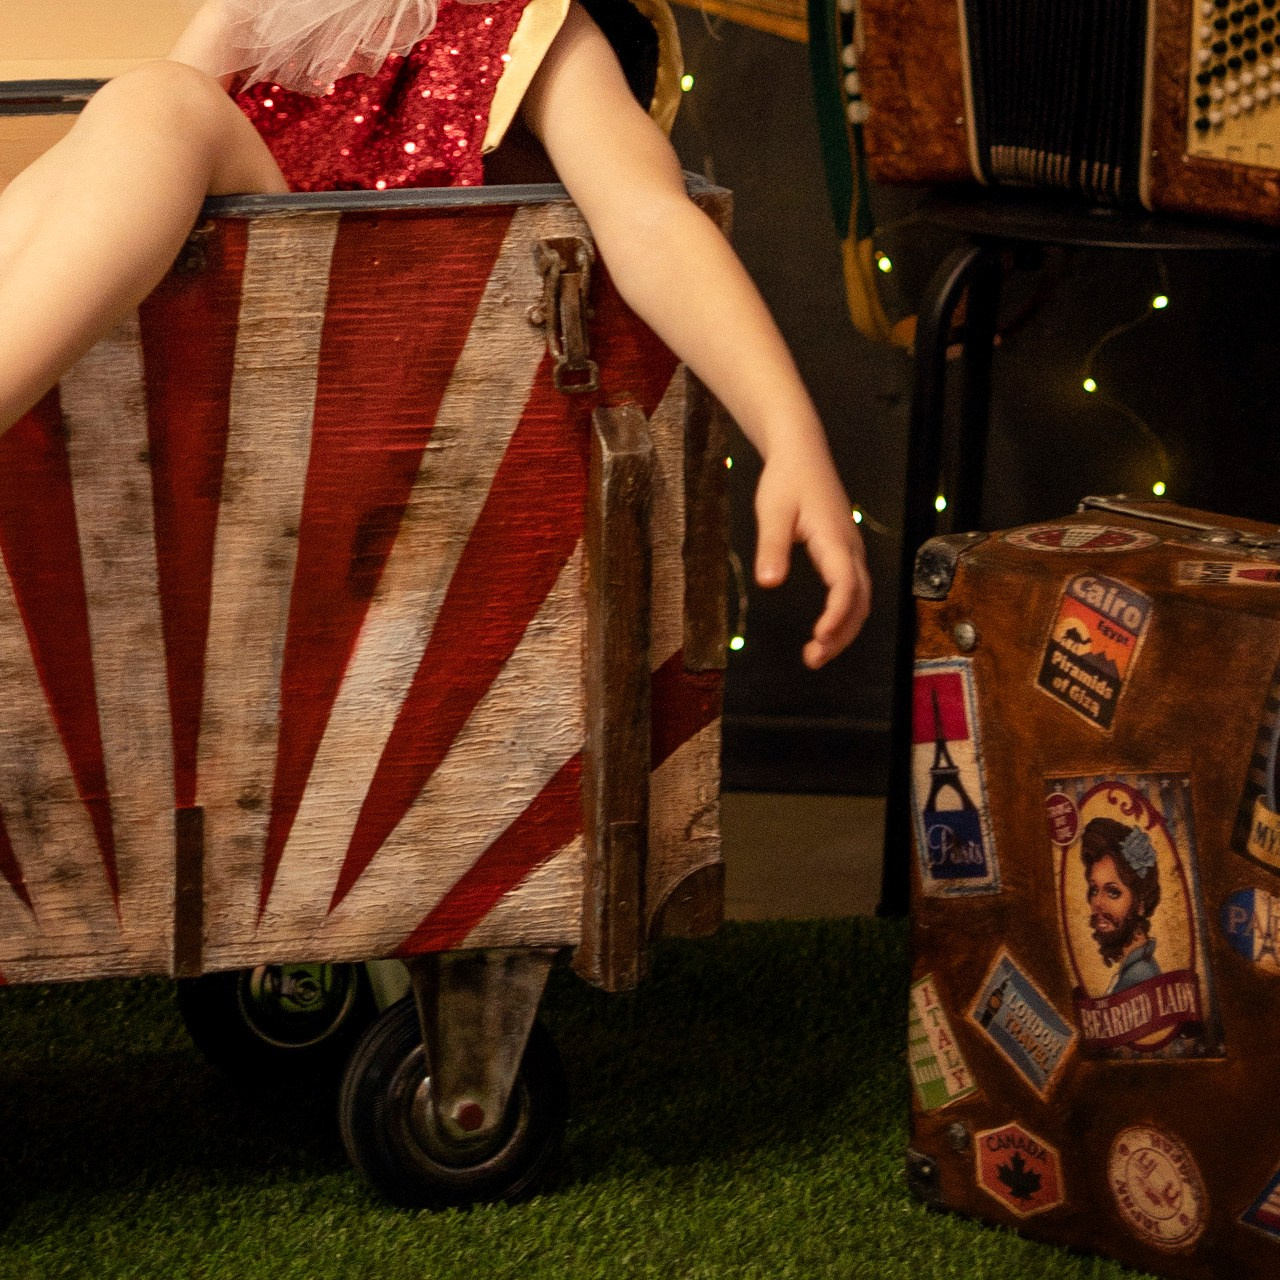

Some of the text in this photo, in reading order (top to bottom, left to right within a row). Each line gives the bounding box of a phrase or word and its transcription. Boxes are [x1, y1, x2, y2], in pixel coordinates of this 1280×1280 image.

[1072, 577, 1141, 628] Cairo
[921, 985, 966, 1090] ITALY
[1080, 982, 1196, 1039] BEARDED LADY
[986, 1135, 1049, 1163] CANADA
